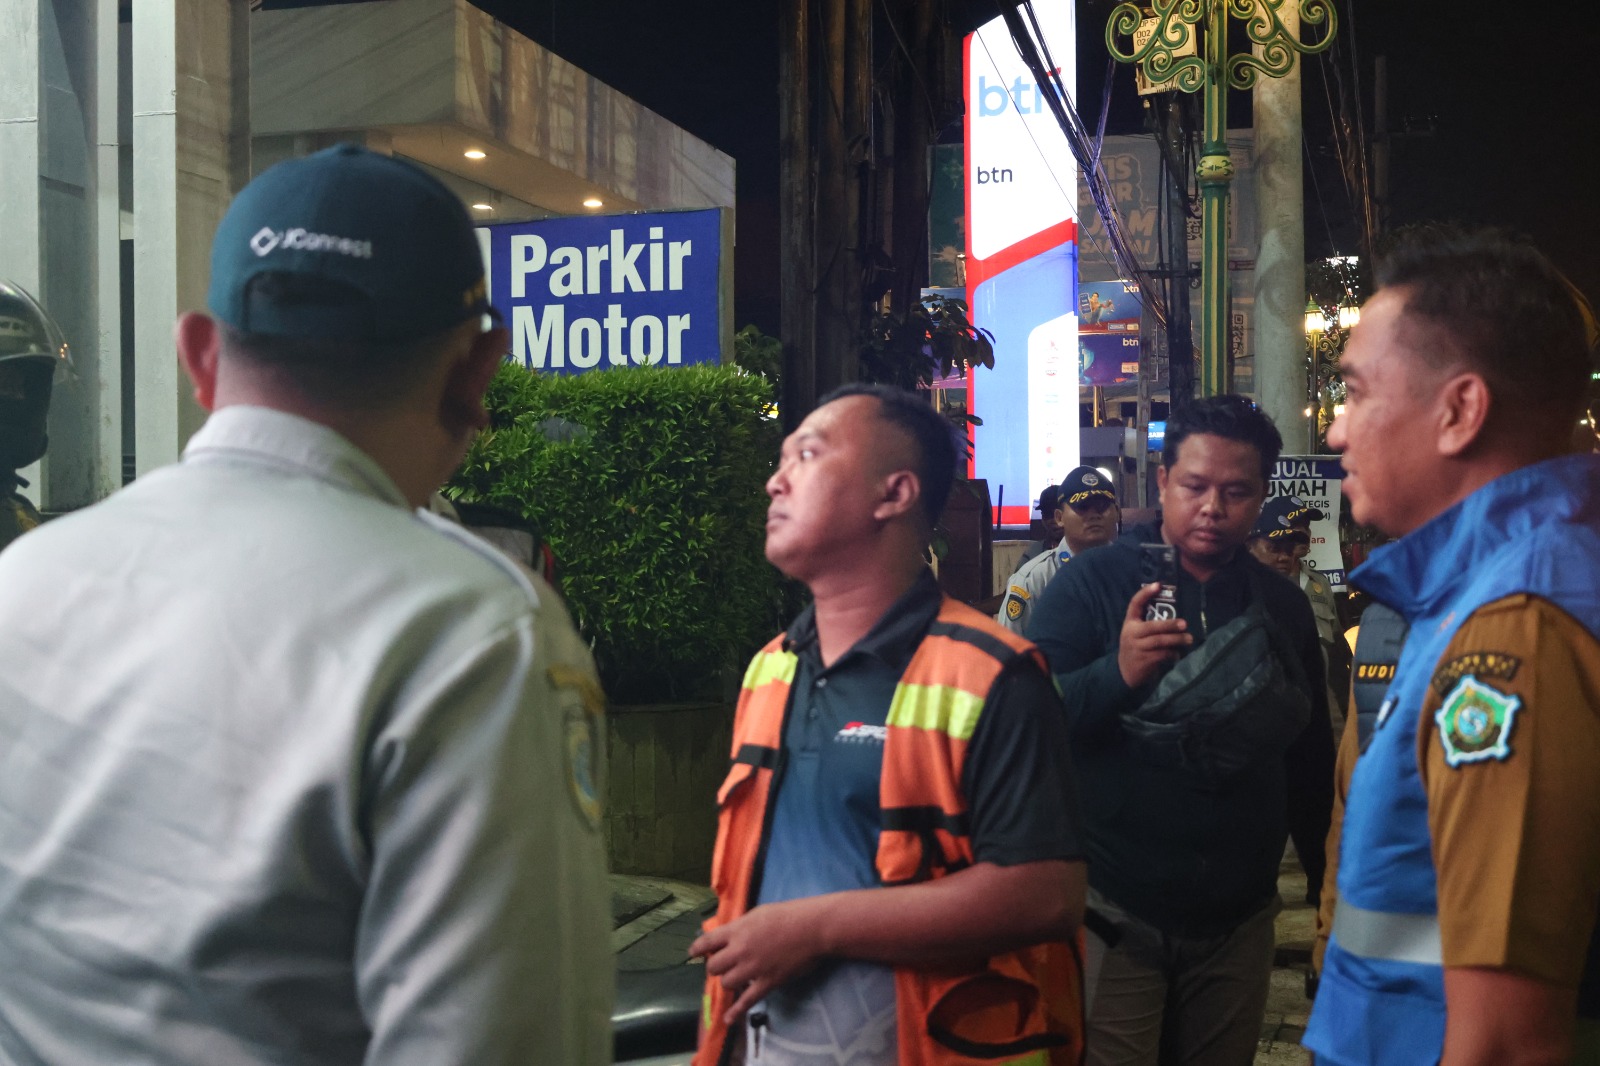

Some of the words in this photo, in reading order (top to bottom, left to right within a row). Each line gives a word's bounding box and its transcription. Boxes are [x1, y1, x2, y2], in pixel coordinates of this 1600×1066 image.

[977, 166, 1013, 184] btn
[510, 226, 692, 298] Parkir
[1123, 284, 1140, 293] btn
[512, 303, 691, 369] Motor
[1122, 337, 1139, 347] btn
